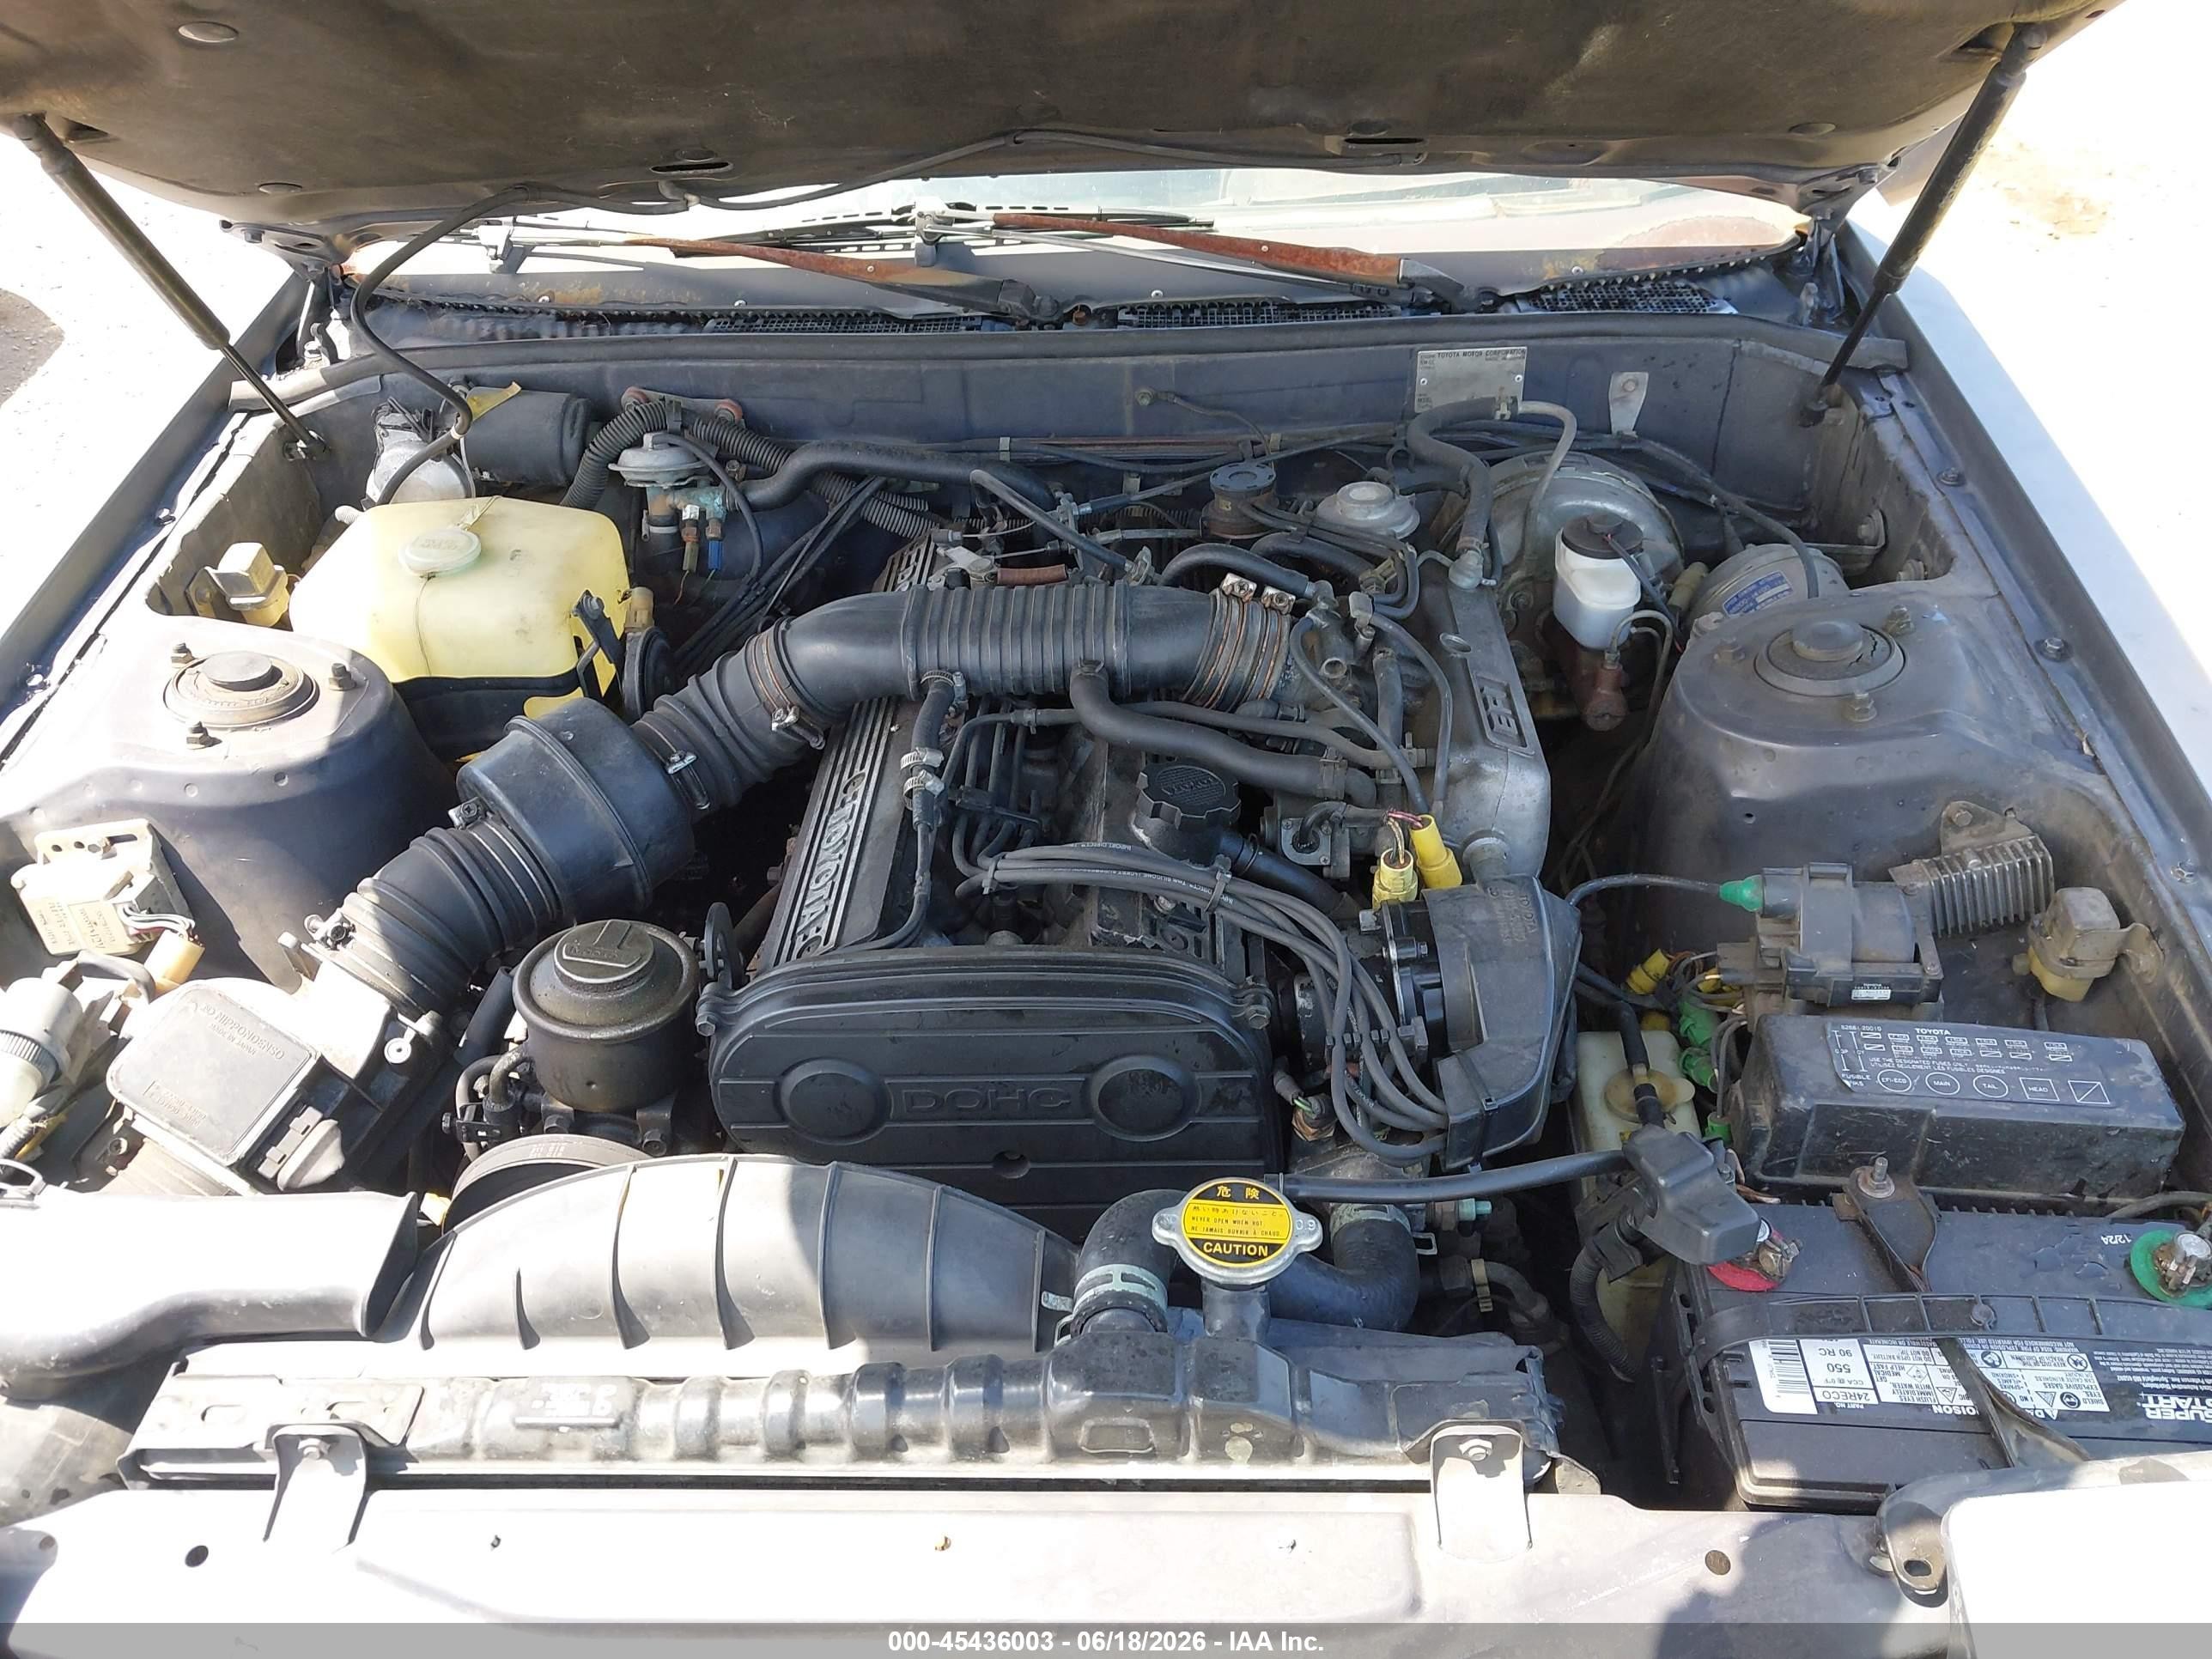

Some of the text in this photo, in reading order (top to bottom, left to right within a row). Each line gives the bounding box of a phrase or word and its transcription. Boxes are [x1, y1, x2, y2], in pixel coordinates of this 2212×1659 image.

[796, 803, 855, 934] TOYOTA
[215, 1012, 285, 1060] NIPPONDENSO
[902, 1088, 1070, 1113] DOHC
[1203, 1242, 1268, 1257] CAUTION
[1818, 1347, 1853, 1358] 90 RC
[1826, 1363, 1851, 1374] 550
[1822, 1390, 1870, 1401] 24RECO
[1893, 1389, 1934, 1397] IMMEDIATELY
[1931, 1405, 1979, 1416] OISON
[2145, 1408, 2212, 1424] SUPER
